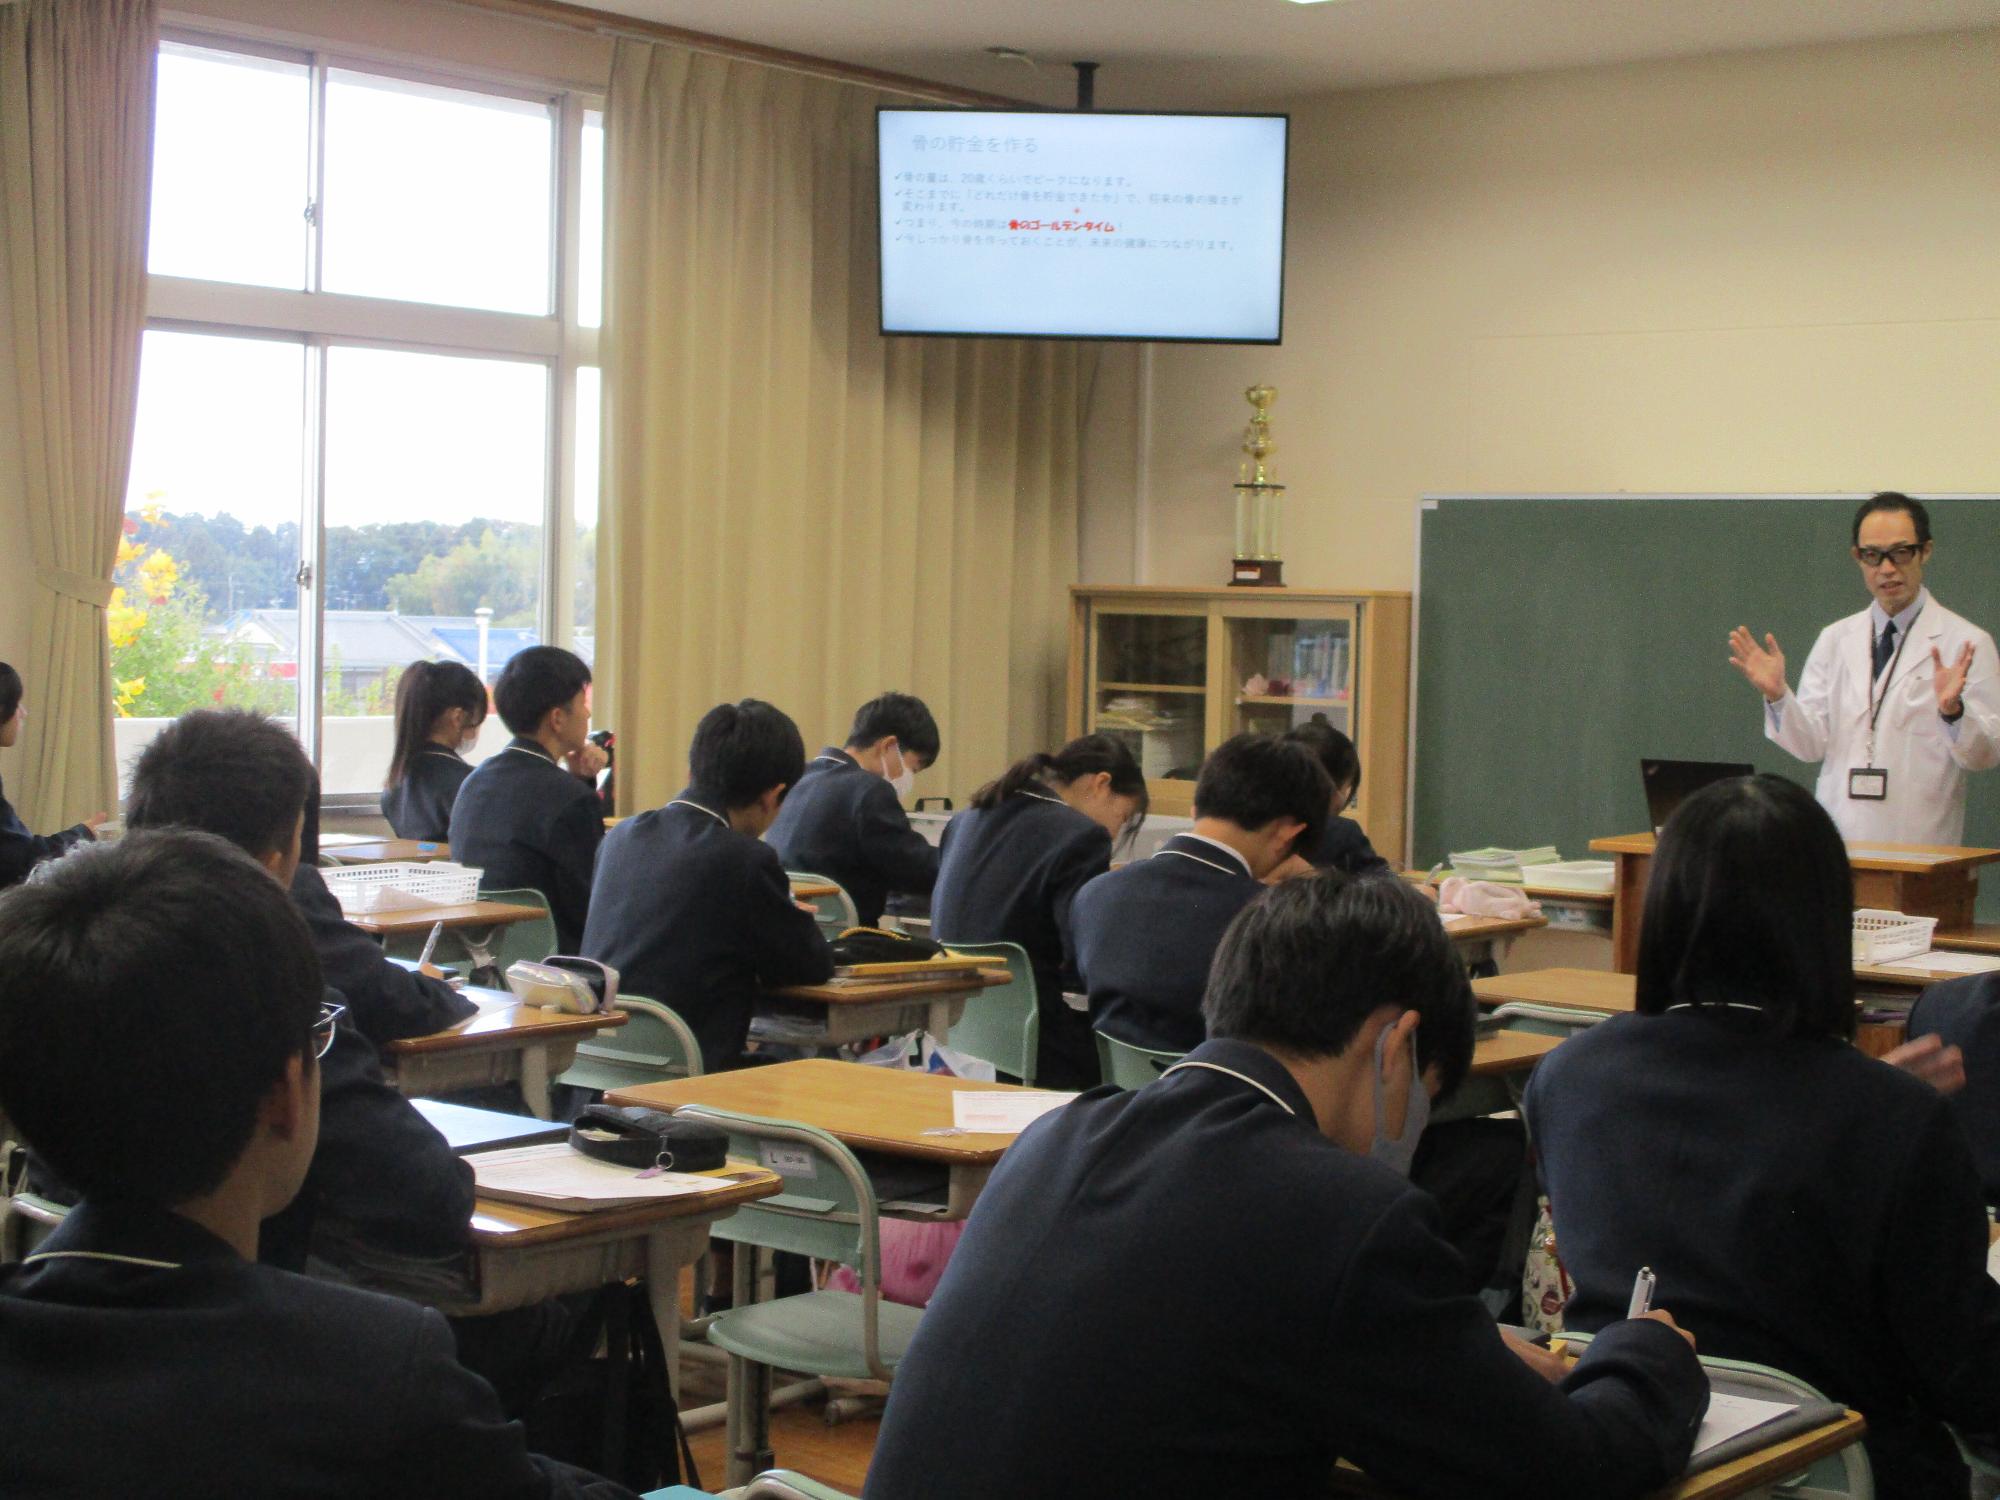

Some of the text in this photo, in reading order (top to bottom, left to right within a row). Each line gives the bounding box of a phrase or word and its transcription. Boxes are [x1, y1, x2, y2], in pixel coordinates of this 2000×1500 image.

[912, 134, 1039, 153] 骨の貯金を作る
